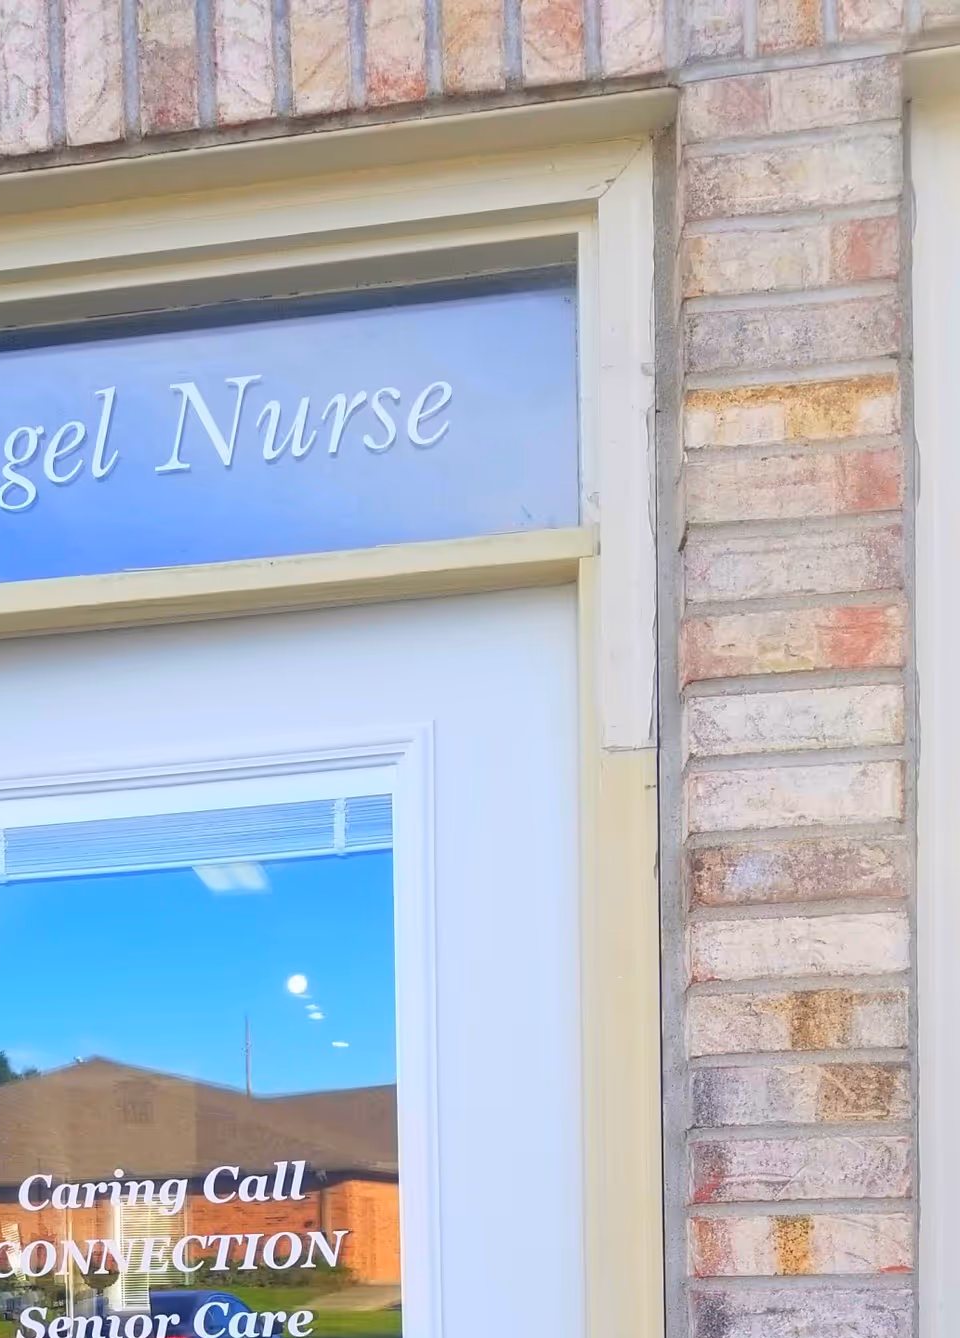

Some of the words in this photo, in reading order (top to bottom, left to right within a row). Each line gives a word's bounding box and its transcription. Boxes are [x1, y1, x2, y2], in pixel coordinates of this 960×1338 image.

[154, 373, 454, 475] Nurse
[17, 1168, 189, 1216] Caring
[202, 1160, 307, 1204] Call
